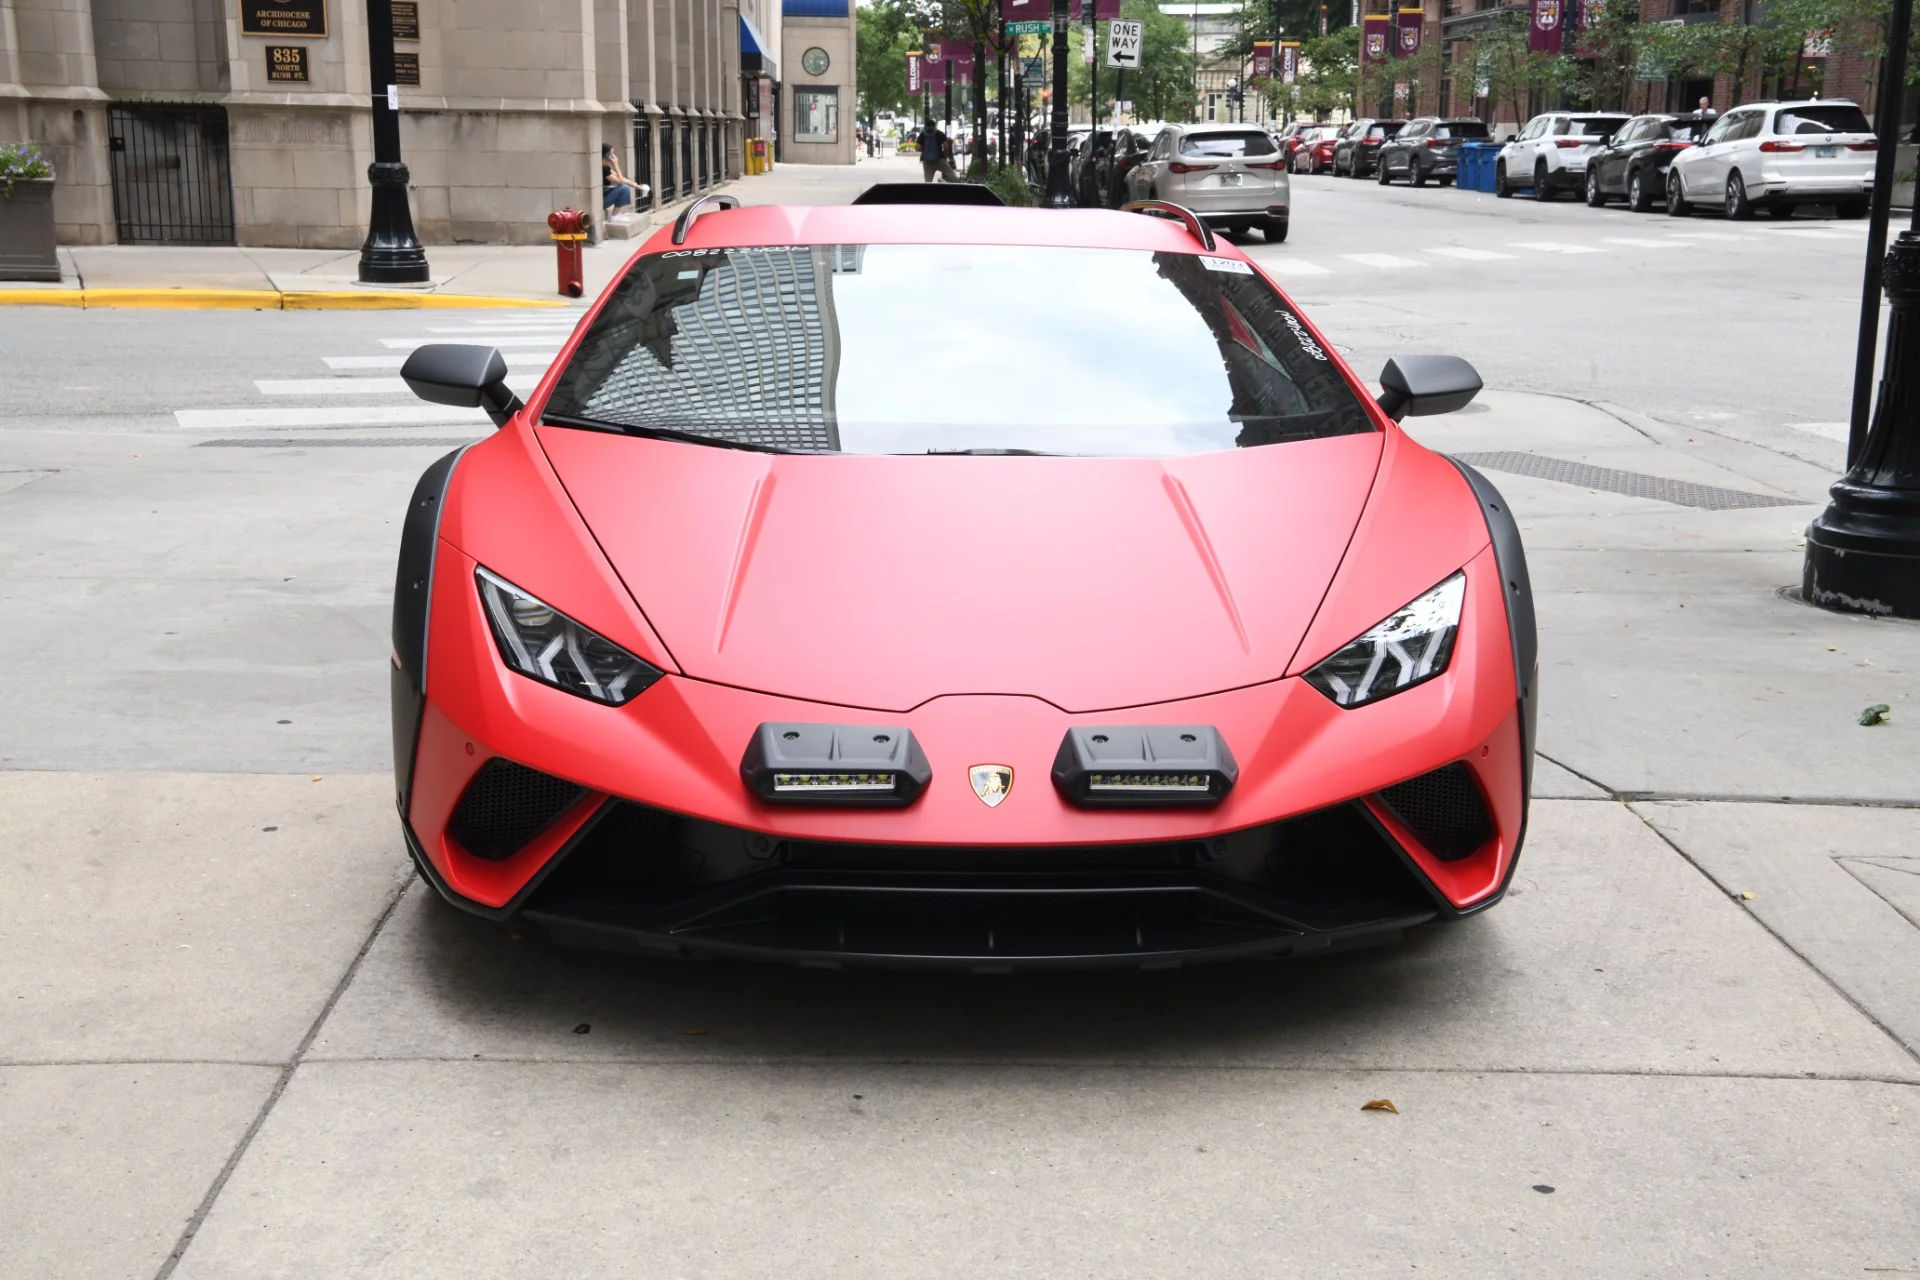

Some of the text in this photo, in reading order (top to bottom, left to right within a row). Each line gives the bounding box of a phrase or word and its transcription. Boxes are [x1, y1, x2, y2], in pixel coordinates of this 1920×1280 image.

[256, 10, 310, 19] ARCHDIOCESE
[272, 20, 307, 28] CHICAGO
[1015, 23, 1040, 34] RUSH
[1113, 23, 1139, 36] ONE
[1112, 36, 1138, 49] WAY
[273, 48, 300, 63] 835
[271, 71, 291, 79] RUSH
[909, 55, 917, 91] WELCOME
